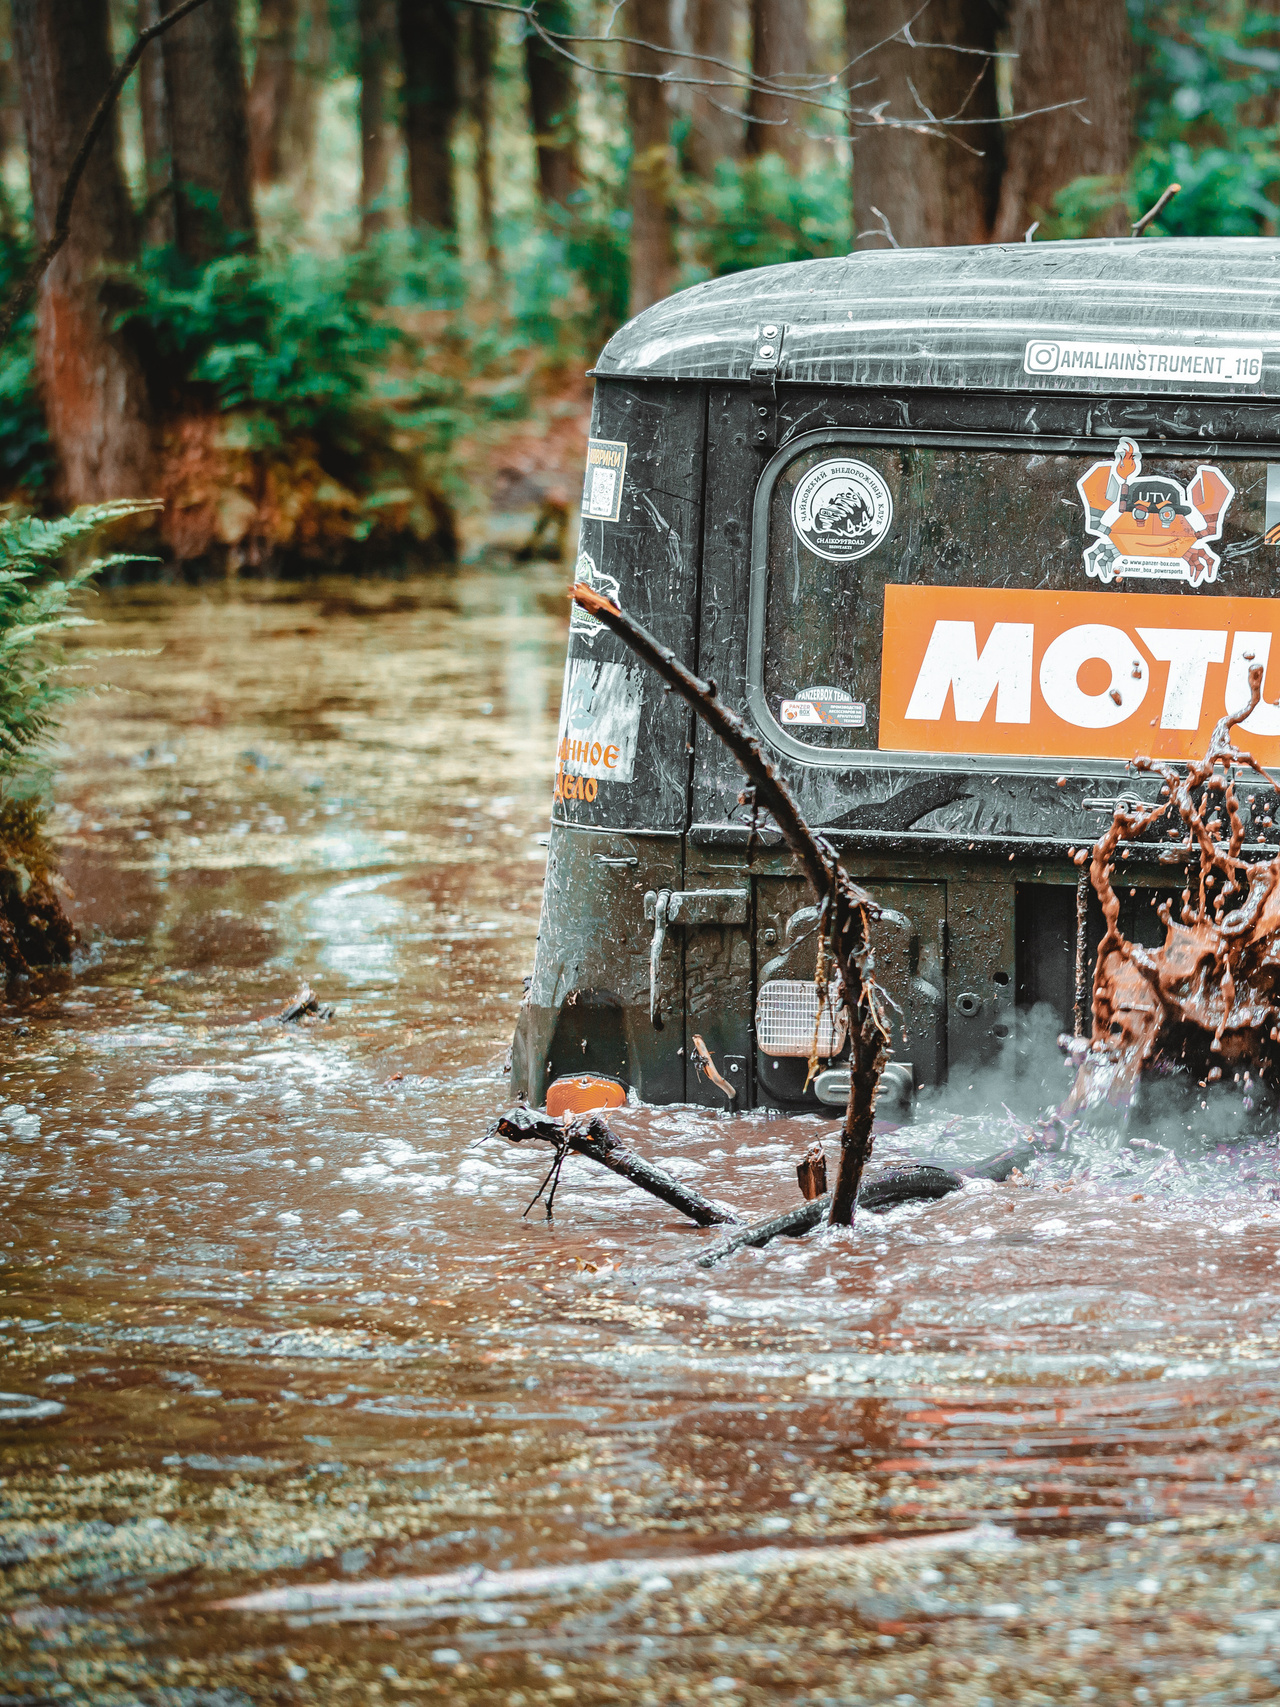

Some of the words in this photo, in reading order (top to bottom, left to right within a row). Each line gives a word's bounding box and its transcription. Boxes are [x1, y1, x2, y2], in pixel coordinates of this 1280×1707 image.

[1061, 350, 1260, 379] AMALIAINSTRUMENT_116
[799, 472, 827, 521] ЧАЙКОВСКИЙ
[831, 467, 883, 499] ВНЕДОРОЖНЫЙ
[1138, 491, 1172, 503] UTV
[1130, 559, 1180, 567] www.panzer-box.com
[1125, 567, 1183, 575] panzer_box_powersports
[798, 689, 833, 701] PANZERBOX
[834, 691, 849, 701] TEAM
